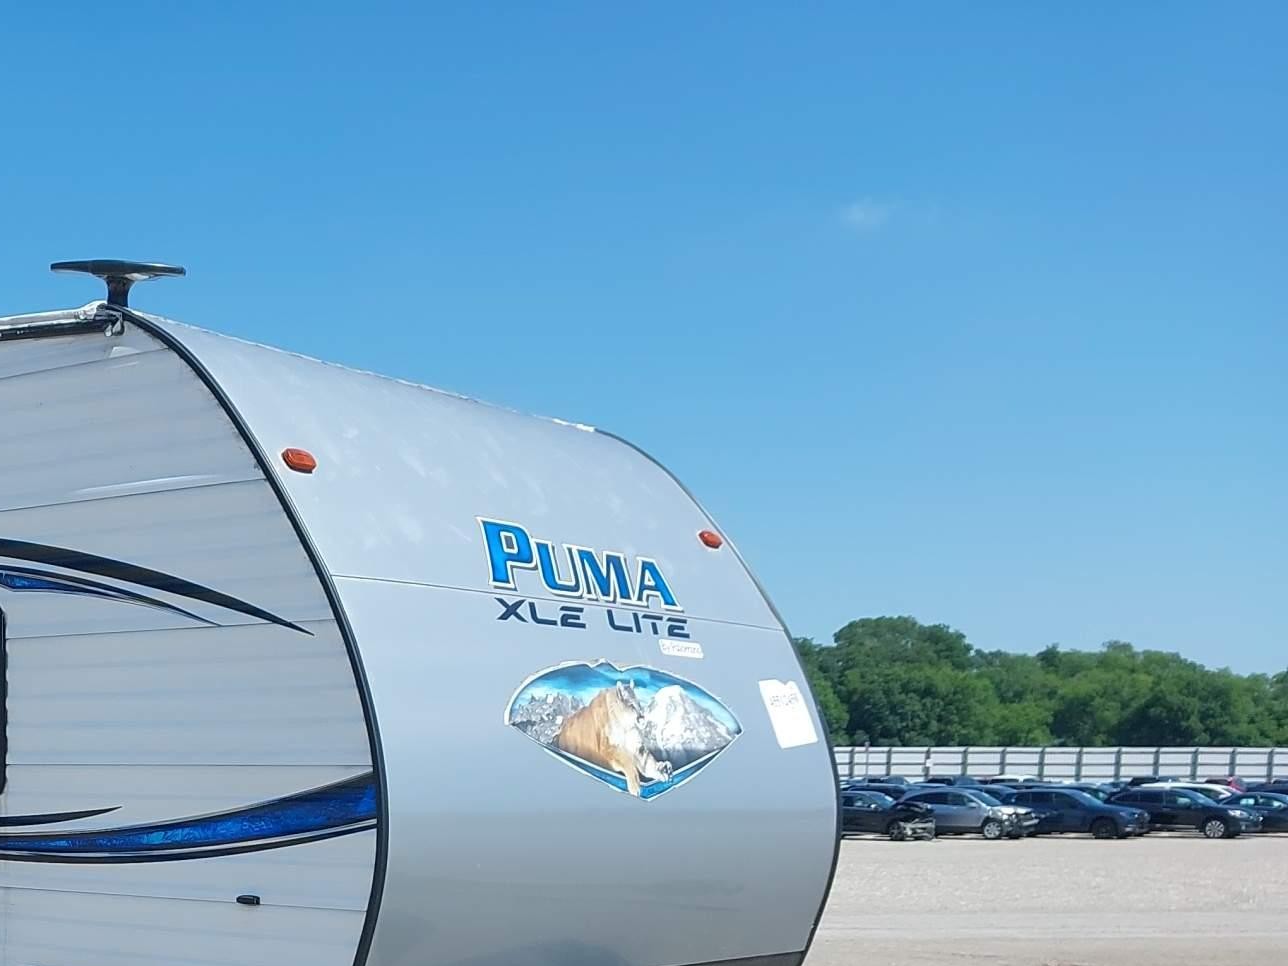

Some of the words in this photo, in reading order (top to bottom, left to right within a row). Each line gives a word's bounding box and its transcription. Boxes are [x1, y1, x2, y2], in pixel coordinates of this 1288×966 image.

[476, 516, 685, 613] PUMA
[494, 597, 587, 630] XLE
[607, 609, 691, 639] LITE
